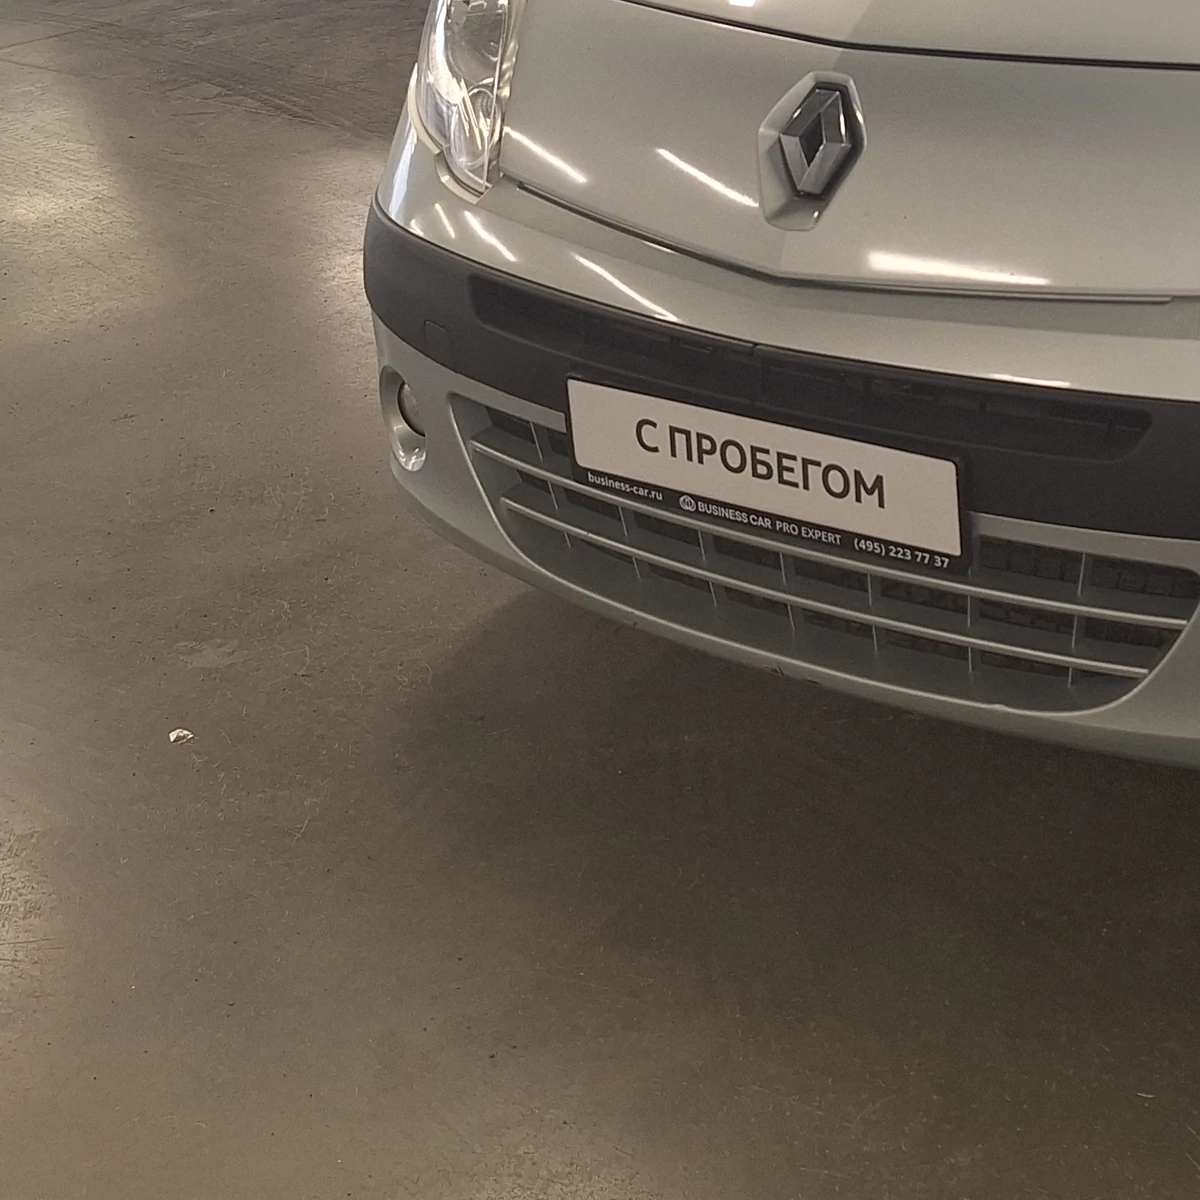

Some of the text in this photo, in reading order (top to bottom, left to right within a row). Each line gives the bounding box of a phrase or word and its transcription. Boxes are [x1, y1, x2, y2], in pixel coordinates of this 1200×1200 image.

[635, 418, 886, 510] С ПРОБЕГОМ
[587, 471, 950, 569] business-car.ru BUSINESS CAR PRO EXPERT (495) 223 77 37
